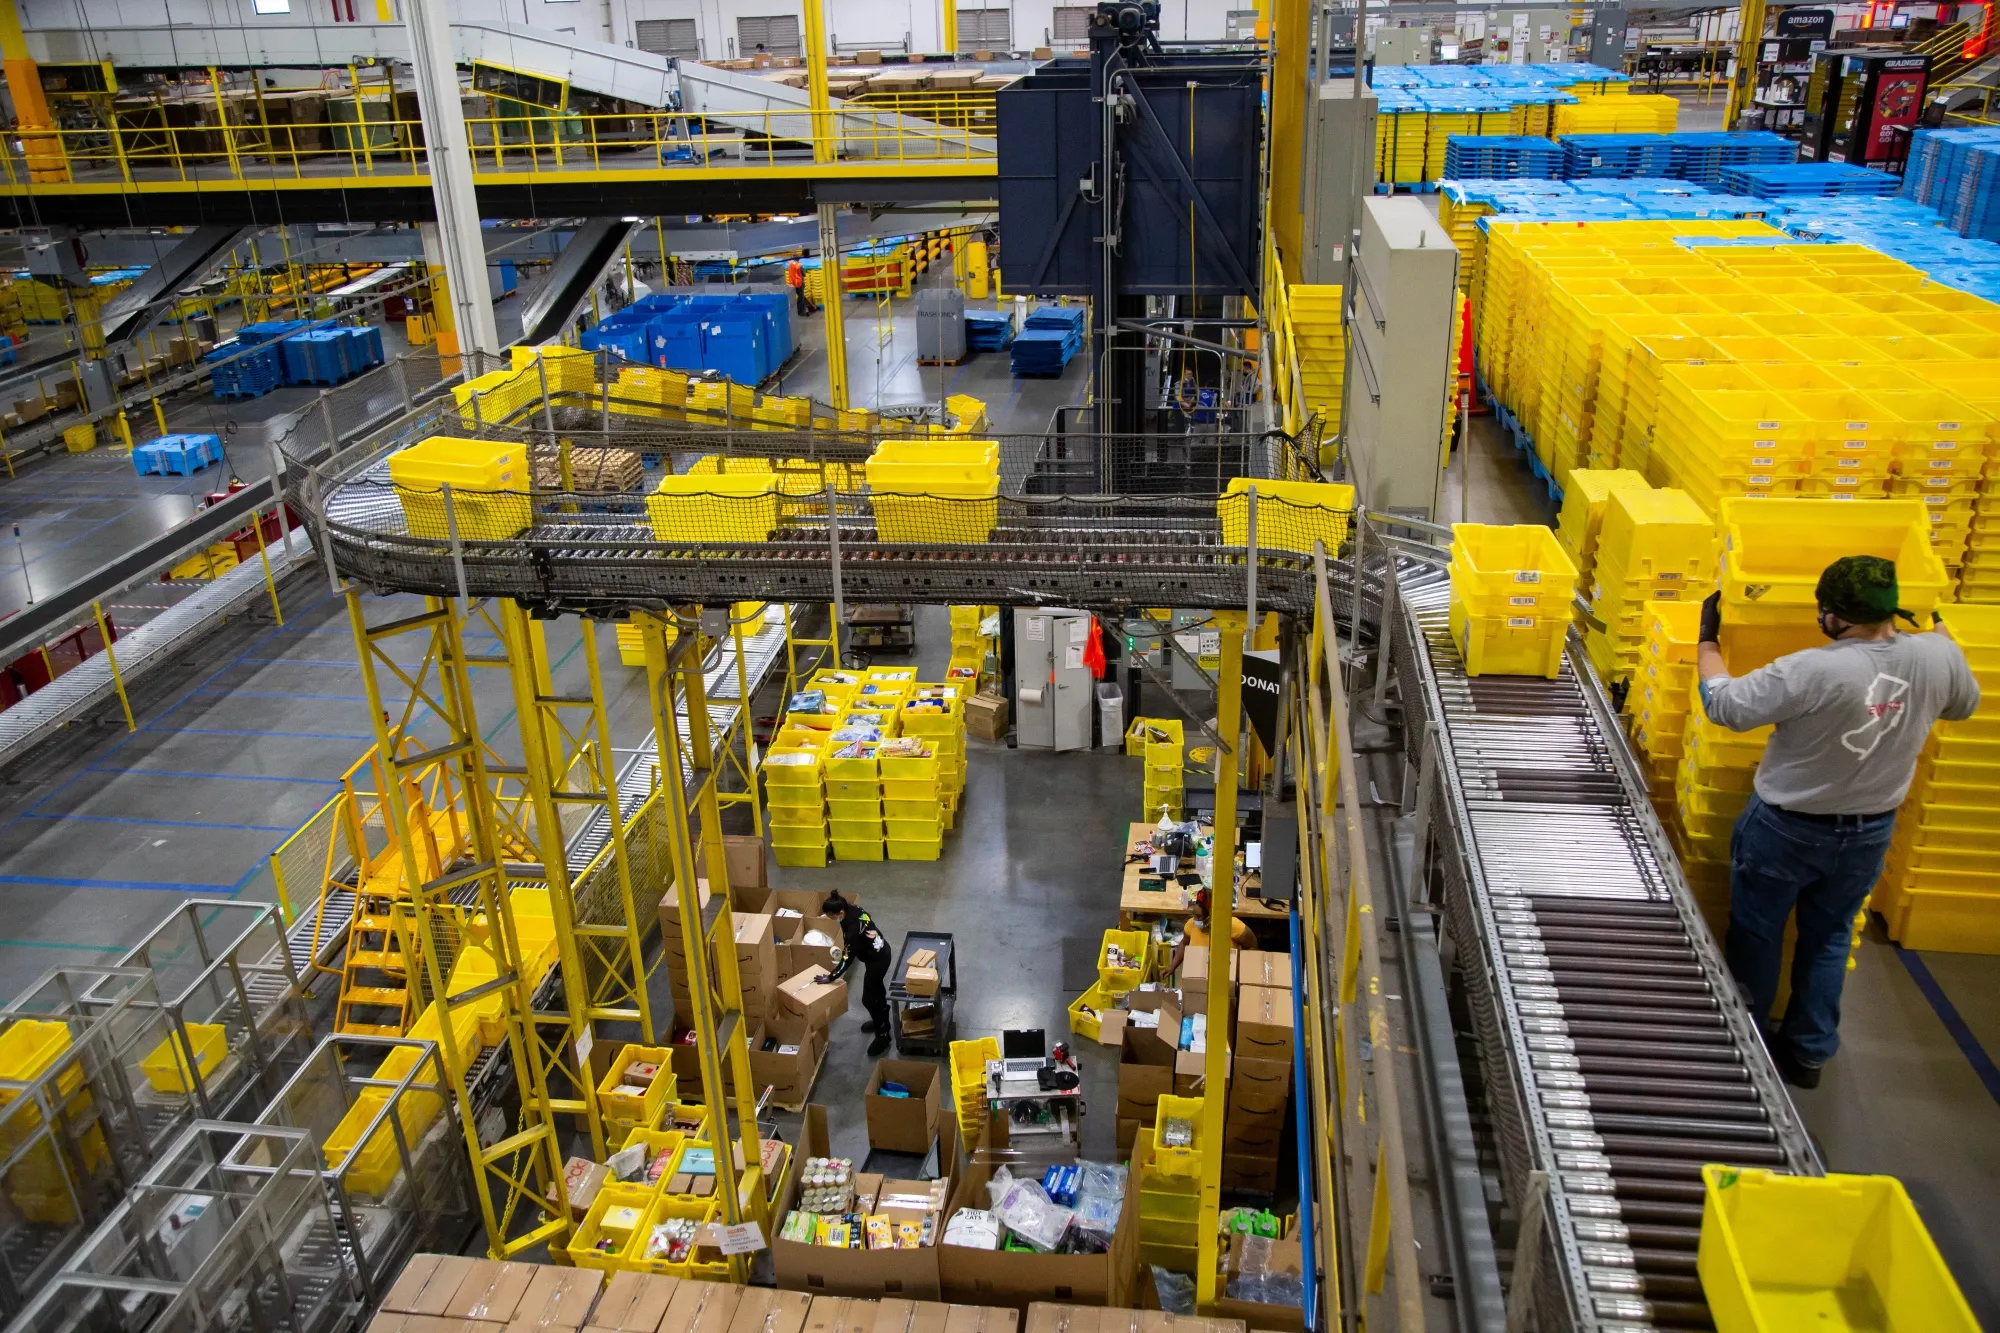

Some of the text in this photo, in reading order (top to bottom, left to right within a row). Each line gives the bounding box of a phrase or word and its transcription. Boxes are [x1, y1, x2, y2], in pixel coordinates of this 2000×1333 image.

[1787, 16, 1825, 24] amazon
[1885, 59, 1925, 67] GRAINGER
[822, 246, 835, 258] 10
